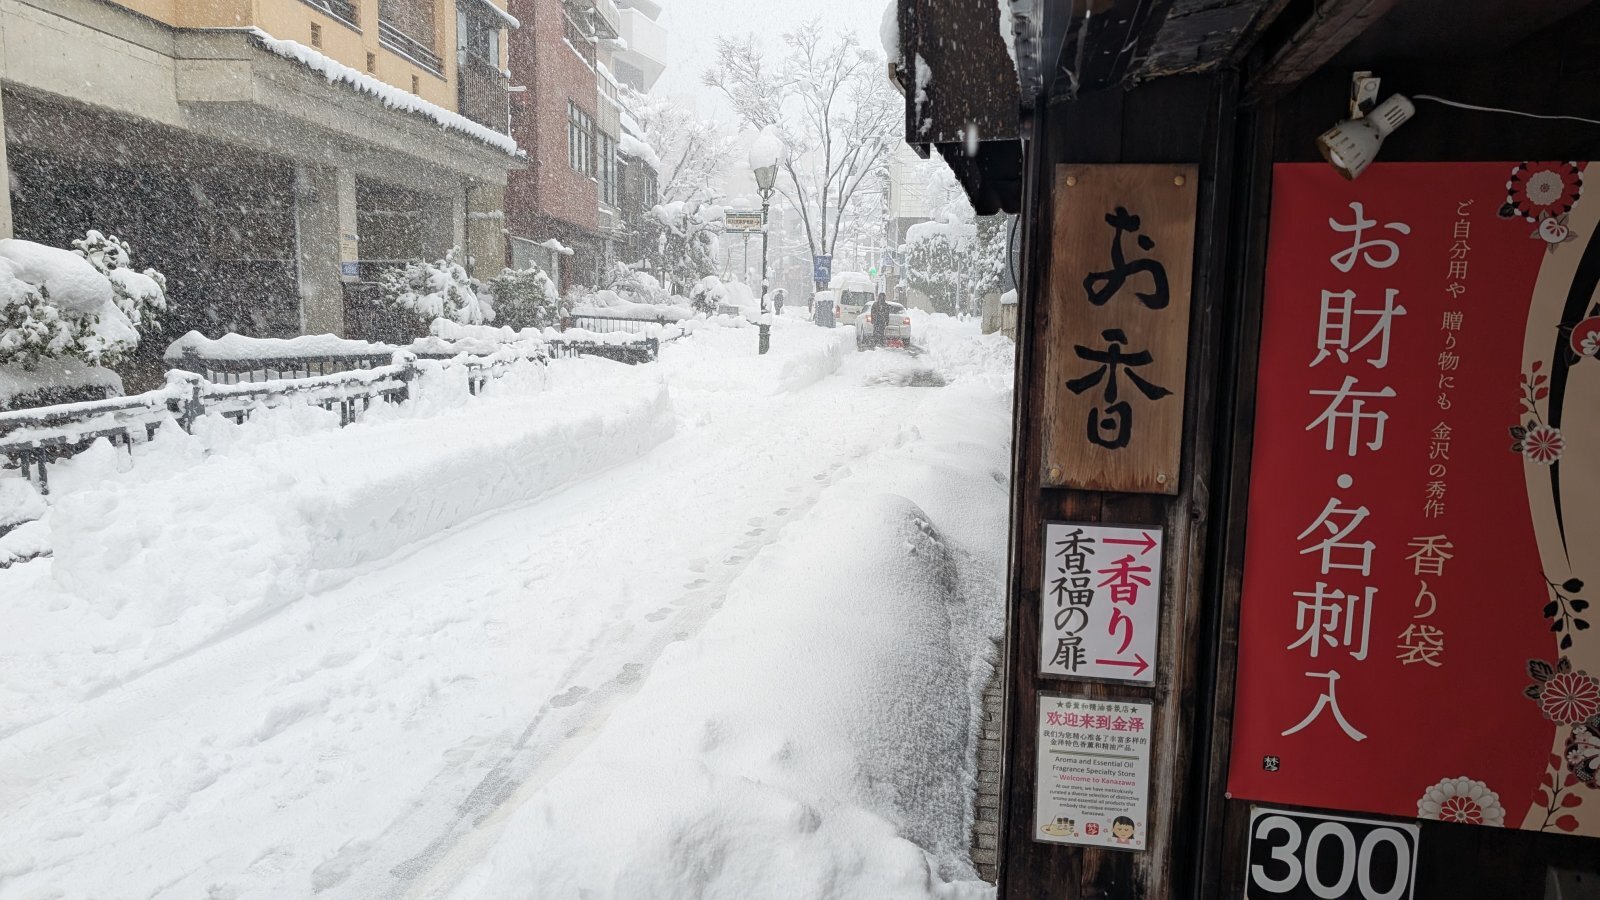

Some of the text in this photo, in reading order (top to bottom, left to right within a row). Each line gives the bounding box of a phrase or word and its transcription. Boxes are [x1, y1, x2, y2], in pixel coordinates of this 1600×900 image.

[1065, 206, 1173, 450] お香
[1423, 199, 1474, 518] ご自分用や 贈り物にも 金沢の秀作
[1281, 202, 1411, 742] お財布・名刺入
[1049, 528, 1096, 672] 香福の扉
[1097, 554, 1151, 655] 香り
[1396, 534, 1454, 668] 香り袋
[1046, 711, 1145, 732] 欢迎来到金泽
[1052, 764, 1136, 777] Fragrance Specialty Store
[1055, 756, 1077, 764] Aroma
[1078, 757, 1091, 765] and
[1093, 759, 1123, 767] Essential
[1059, 774, 1091, 783] Welcome
[1101, 778, 1136, 786] Kanazawa
[1251, 816, 1410, 900] 300
